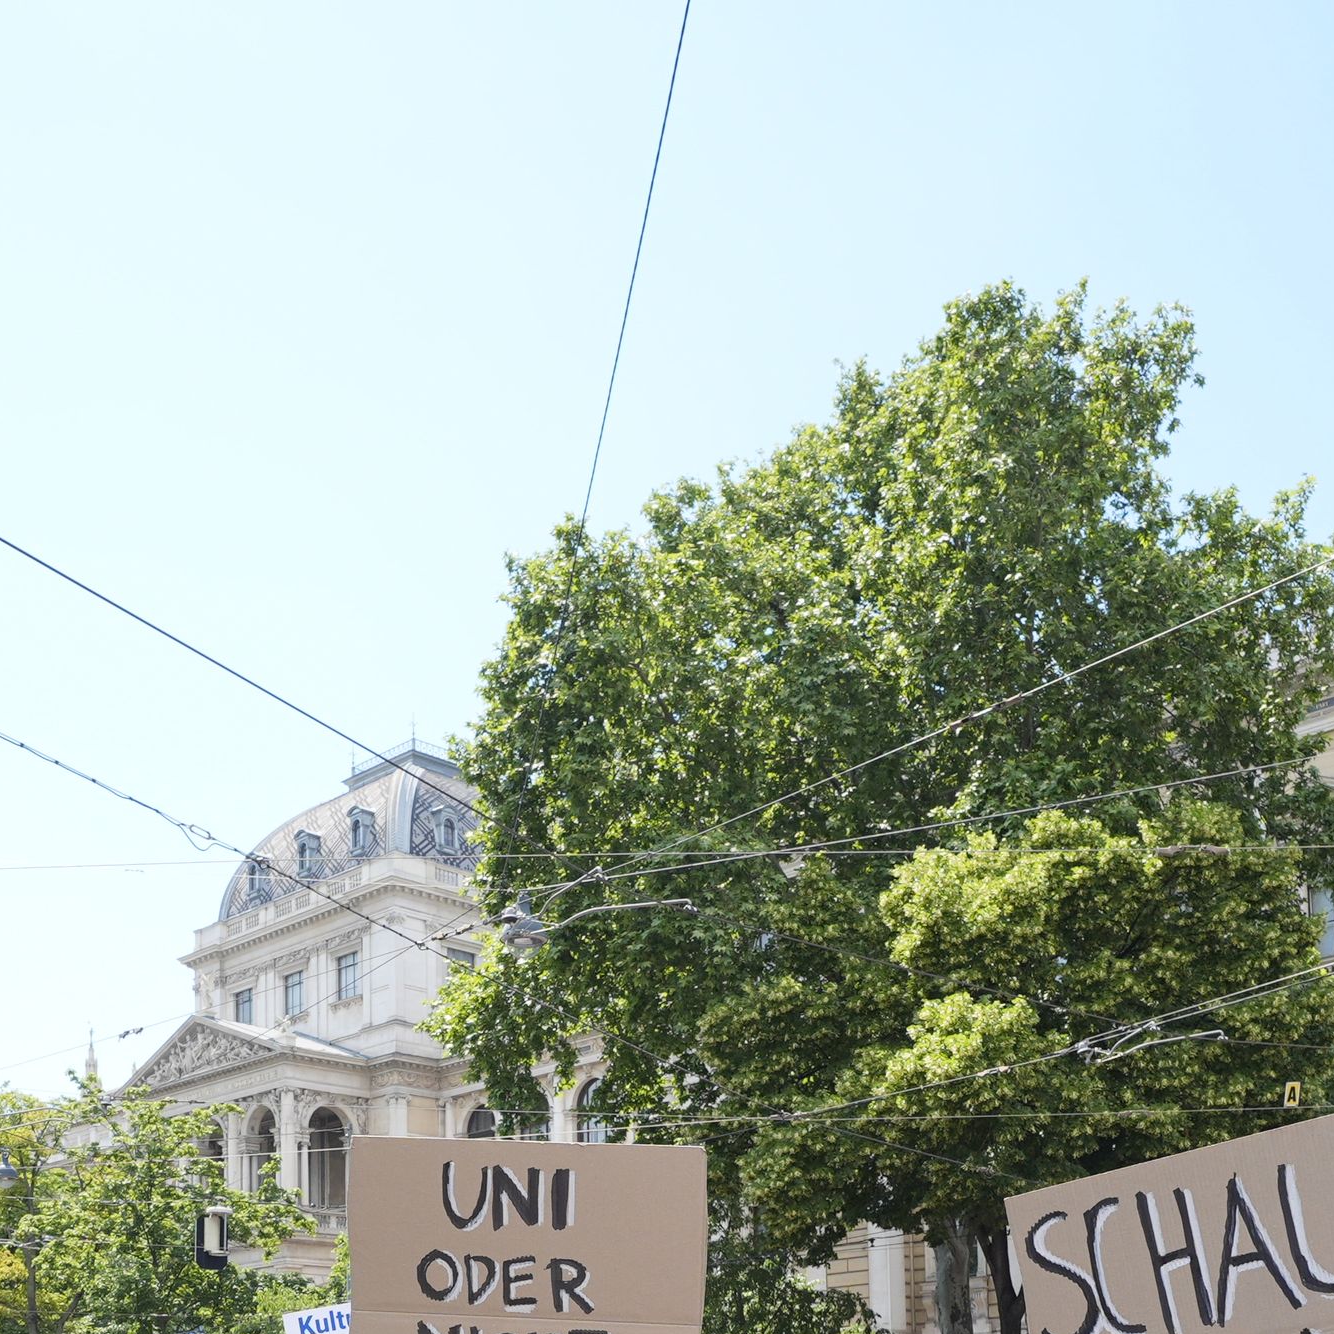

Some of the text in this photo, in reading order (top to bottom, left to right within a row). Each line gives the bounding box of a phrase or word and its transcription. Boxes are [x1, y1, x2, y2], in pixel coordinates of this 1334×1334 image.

[1288, 1086, 1296, 1102] A
[441, 1160, 577, 1232] UNI
[416, 1248, 596, 1315] ODER
